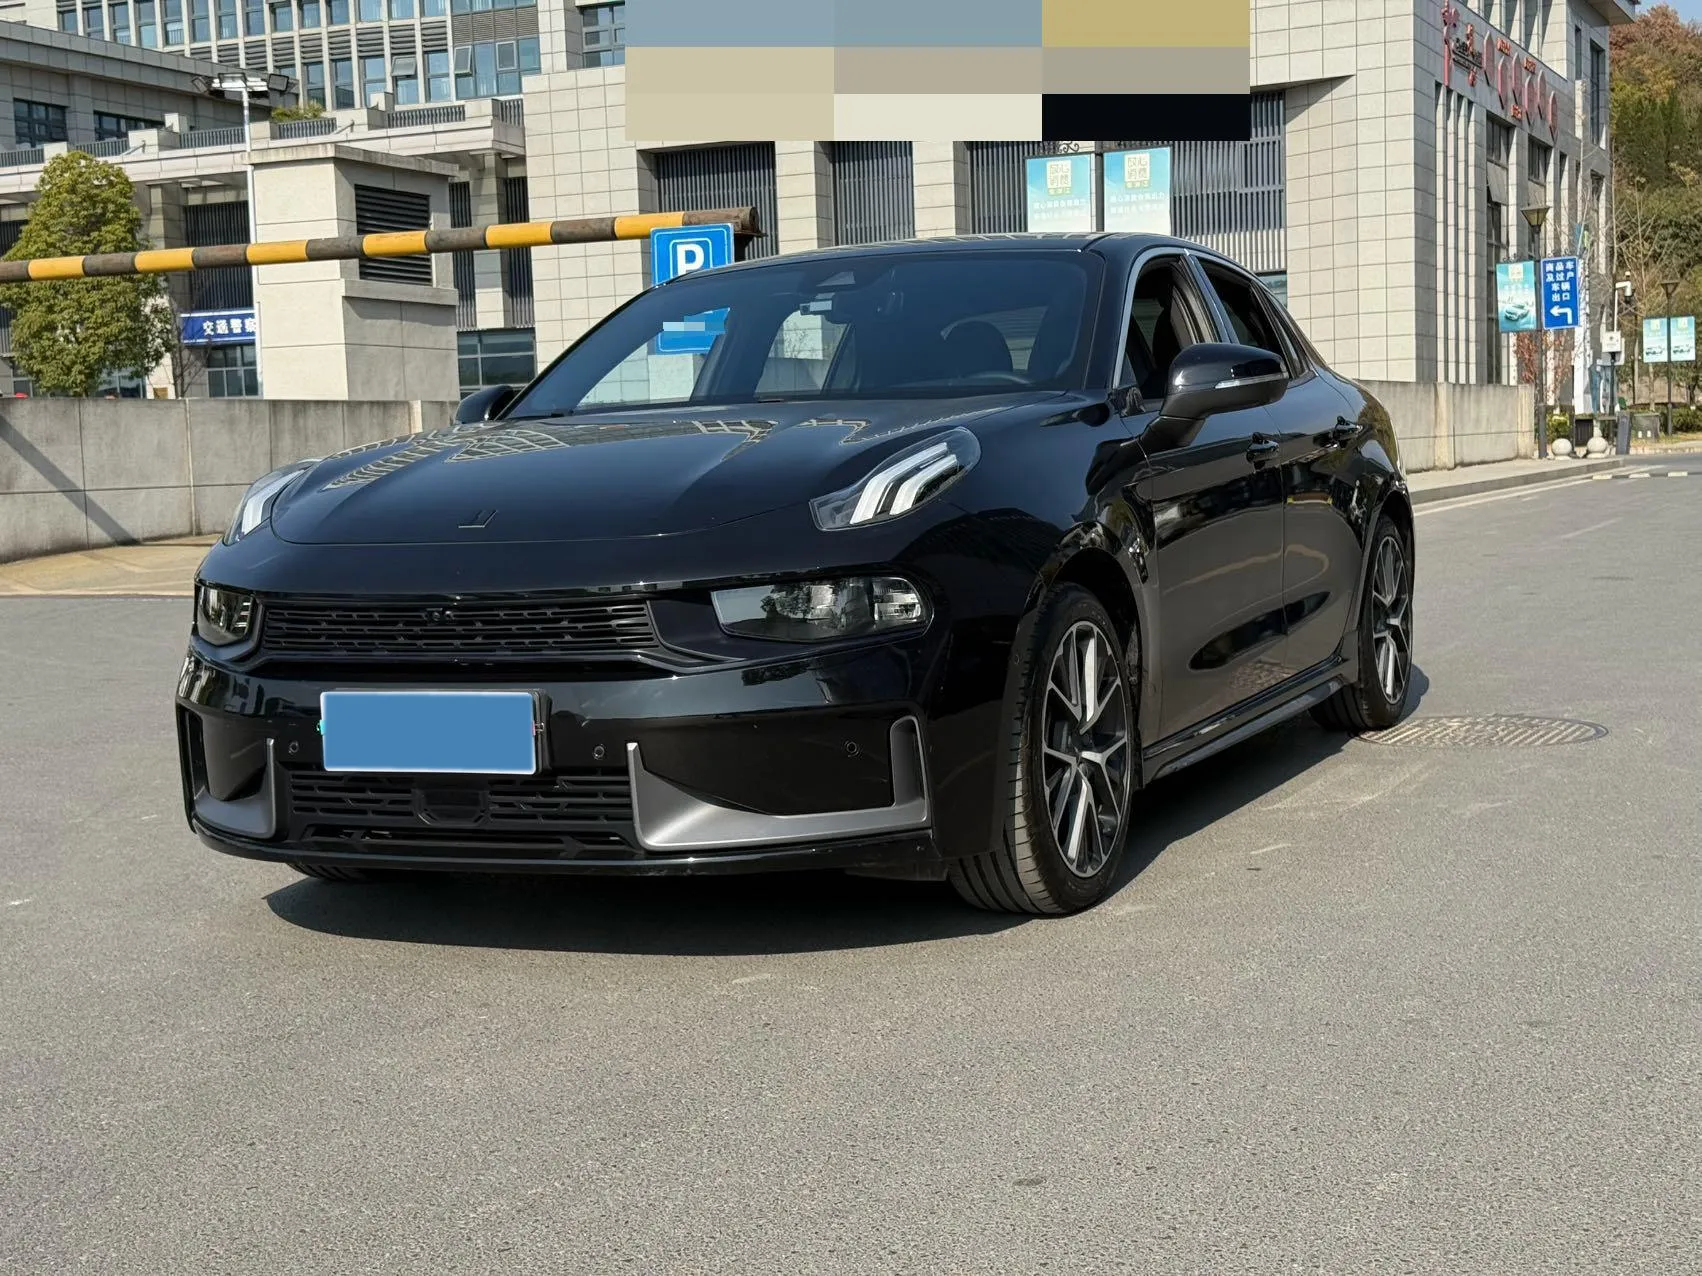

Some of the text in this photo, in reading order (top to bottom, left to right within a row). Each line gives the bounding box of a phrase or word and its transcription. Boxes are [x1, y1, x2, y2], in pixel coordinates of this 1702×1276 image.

[677, 244, 704, 276] P
[1546, 261, 1574, 272] 商品车
[1546, 272, 1574, 282] 及过户
[1552, 282, 1571, 291] 车辆
[1552, 292, 1570, 302] 出口
